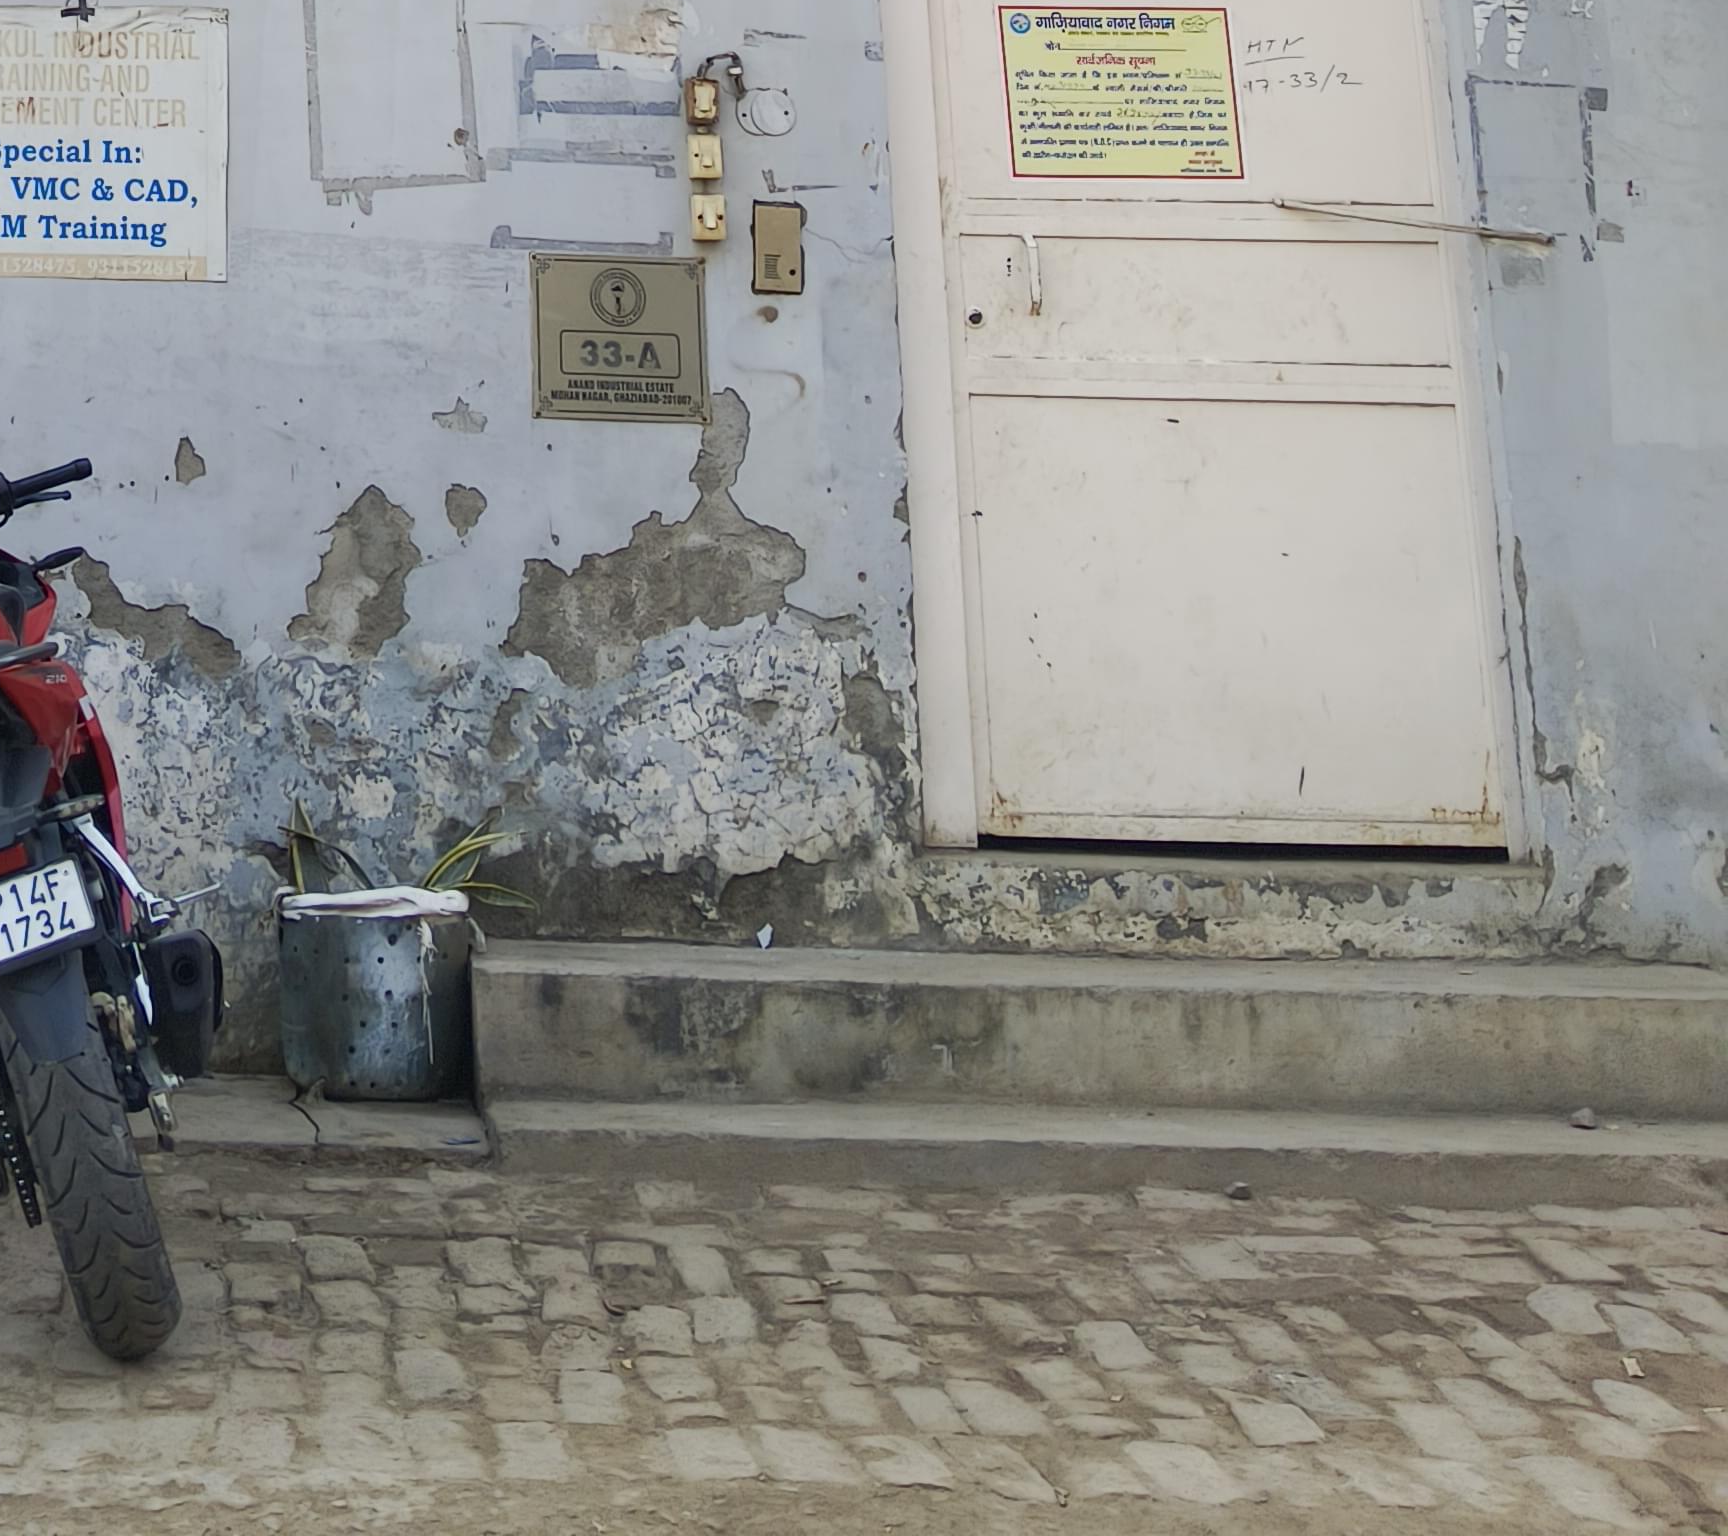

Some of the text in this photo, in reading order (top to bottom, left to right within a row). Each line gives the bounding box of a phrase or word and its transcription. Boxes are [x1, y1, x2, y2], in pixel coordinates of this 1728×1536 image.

[1106, 17, 1135, 30] नगर
[1139, 13, 1175, 30] निगम
[53, 31, 200, 60] INDUSTRIAL
[100, 64, 150, 93] AND
[93, 98, 186, 128] CENTER
[102, 140, 141, 164] In:
[11, 176, 80, 201] VMC
[92, 178, 114, 201] &
[125, 179, 198, 207] CAD,
[38, 215, 167, 247] Training
[579, 339, 662, 369] 33-A
[551, 390, 580, 400] MOHAN
[568, 380, 674, 393] ANAND INDUSTRIAL ESTATE
